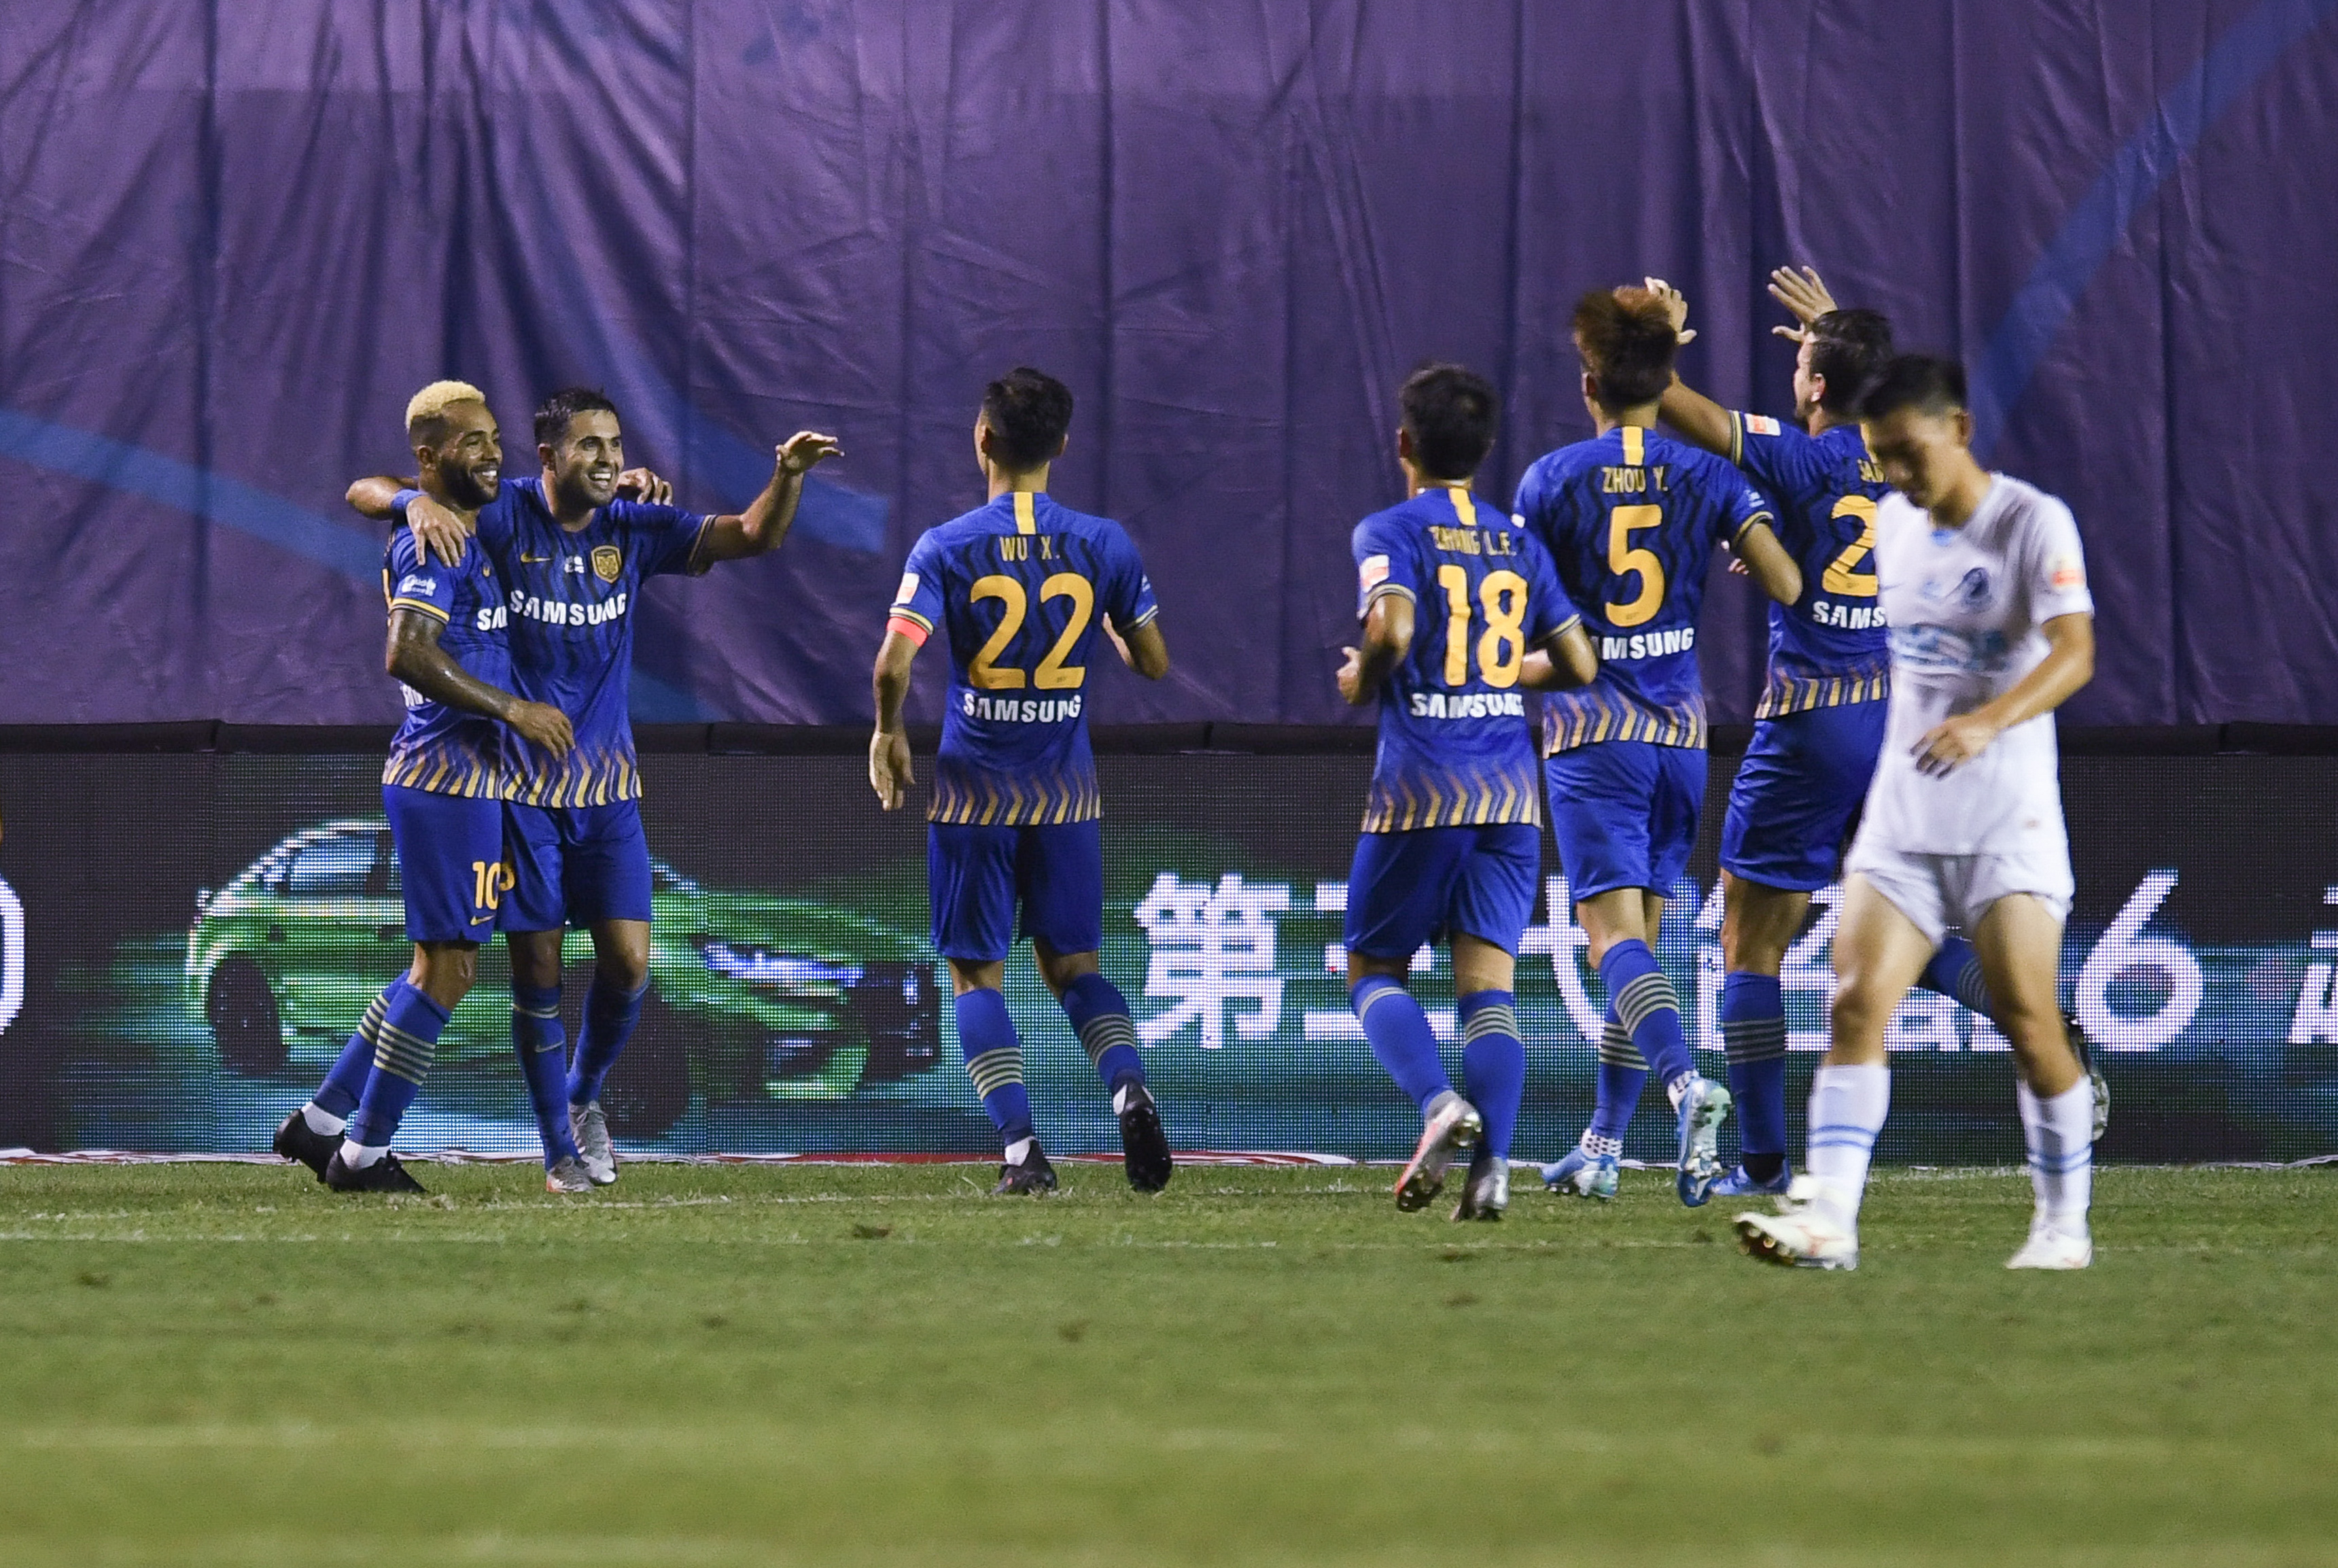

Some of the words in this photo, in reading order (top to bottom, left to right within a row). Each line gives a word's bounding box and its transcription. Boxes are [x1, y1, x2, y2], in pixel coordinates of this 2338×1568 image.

[1601, 466, 1646, 493] ZHOU
[1652, 466, 1669, 492] Y.
[999, 536, 1029, 562] WU
[1040, 535, 1061, 560] X.
[1605, 504, 1665, 627] 5
[510, 589, 627, 626] SAMSUNG
[1813, 600, 1886, 629] SAMS
[968, 572, 1094, 690] 22
[1437, 564, 1528, 689] 18
[963, 693, 1081, 723] SAMSUNG
[1410, 692, 1525, 719] SAMSUNG
[472, 860, 502, 910] 10
